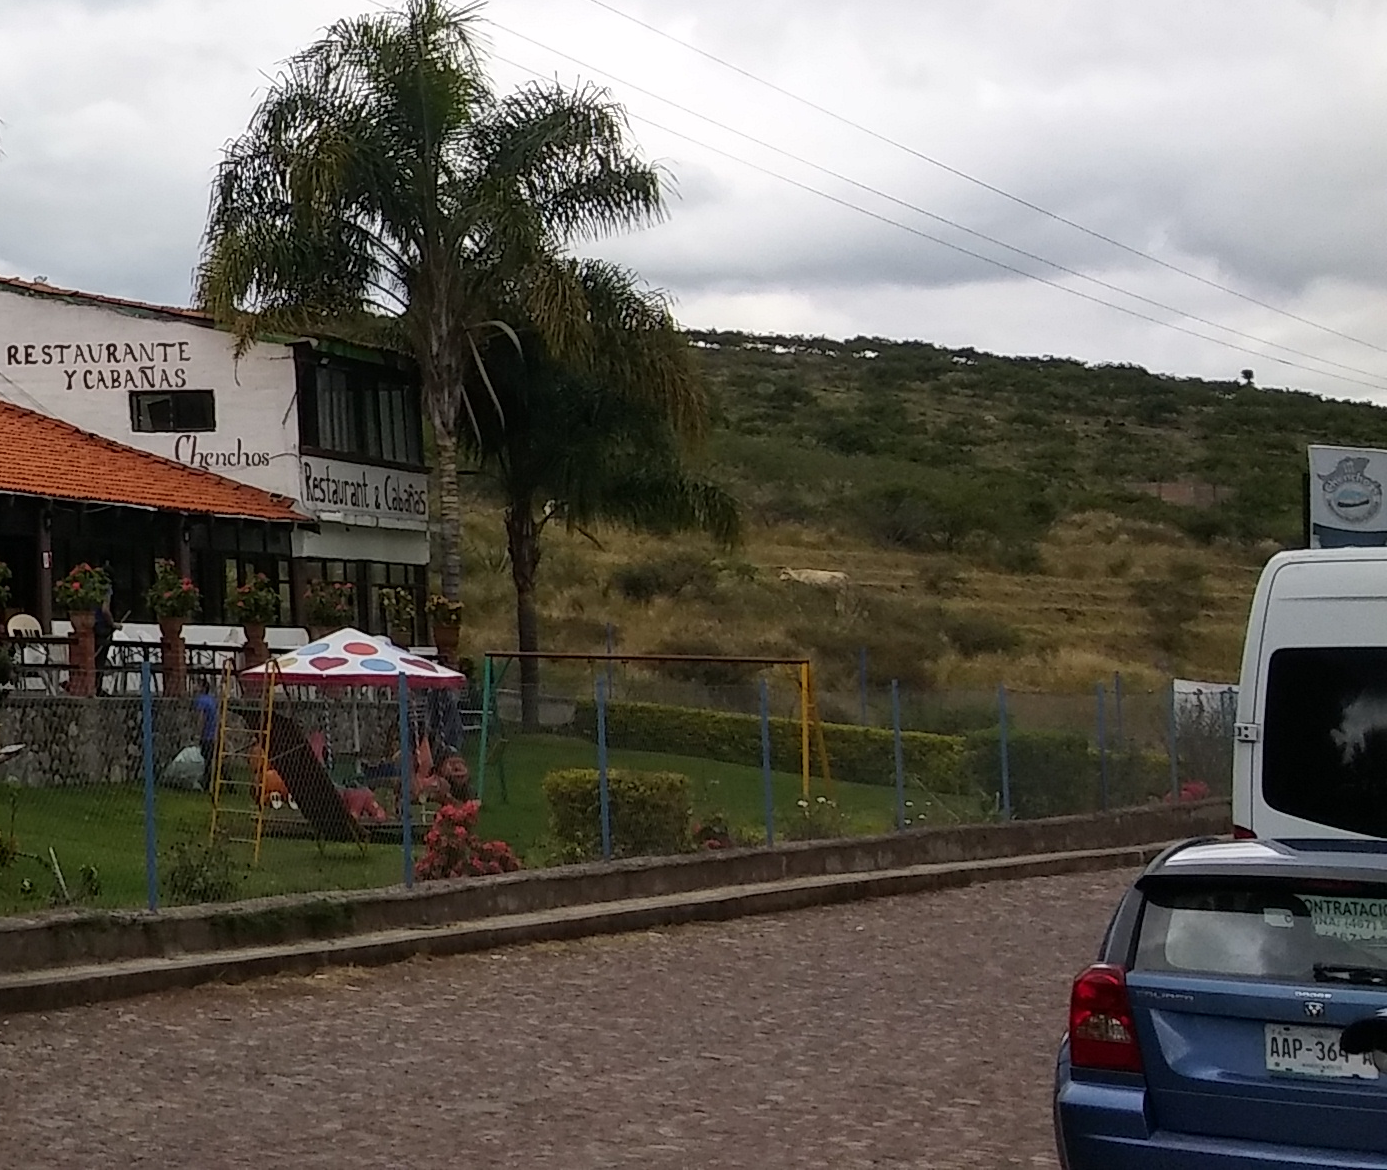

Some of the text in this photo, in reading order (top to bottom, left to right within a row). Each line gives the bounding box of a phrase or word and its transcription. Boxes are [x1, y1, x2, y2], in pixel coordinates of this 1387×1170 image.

[6, 341, 192, 366] RESTAURANTE
[63, 364, 187, 391] Y CABAÑAS
[174, 434, 270, 470] Chenchos
[303, 461, 370, 509] Restaurant
[384, 475, 427, 515] Cabañas
